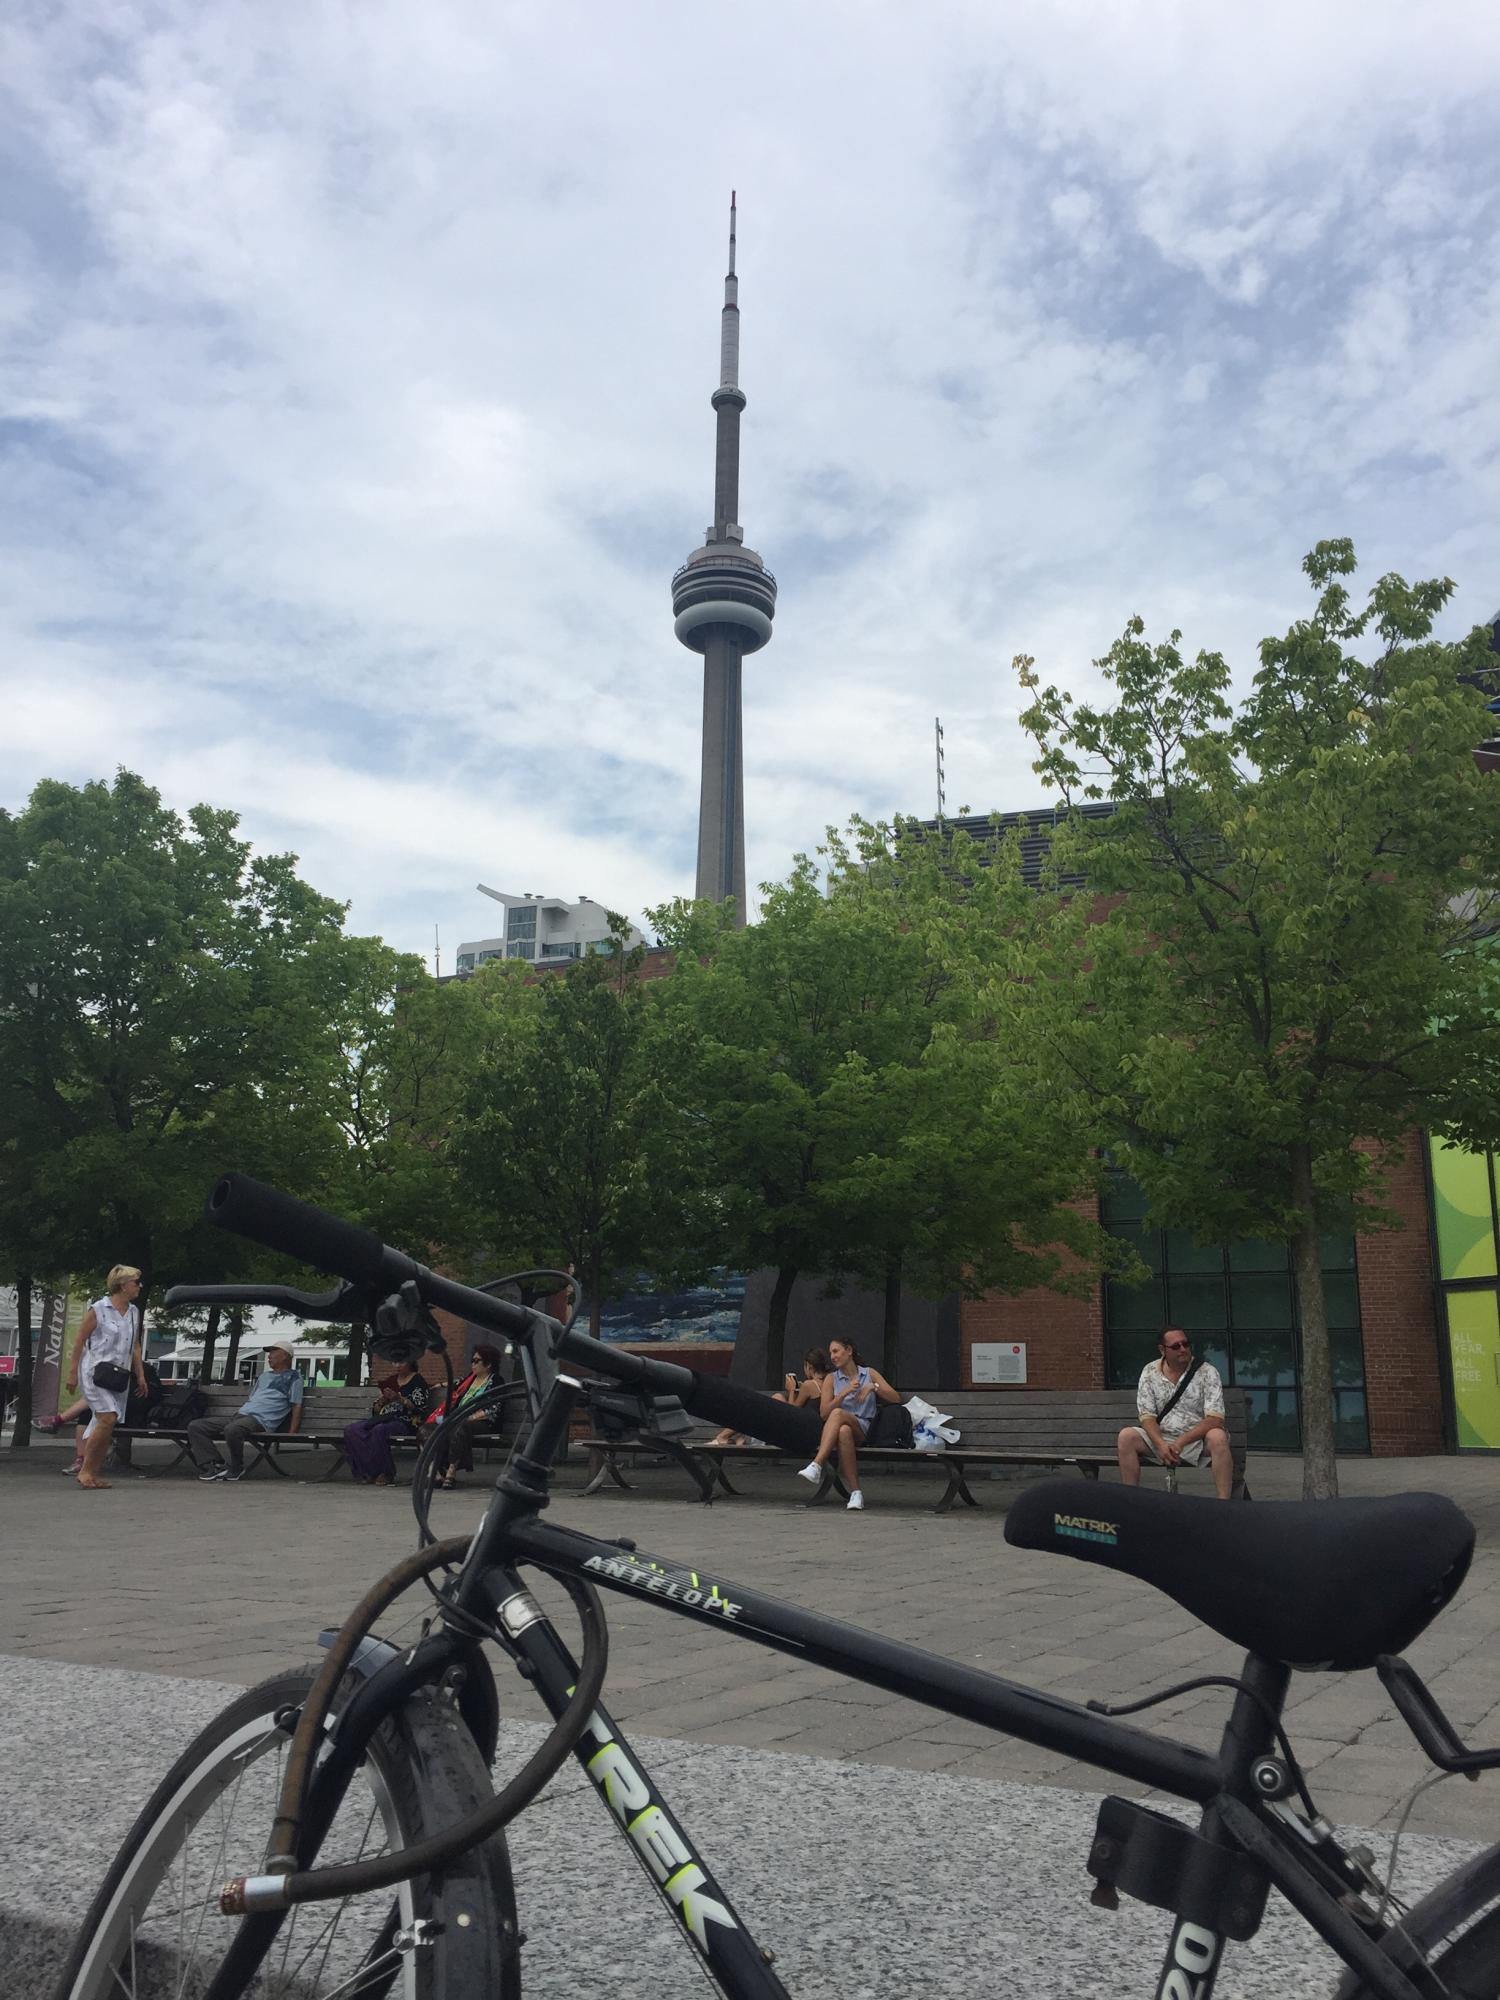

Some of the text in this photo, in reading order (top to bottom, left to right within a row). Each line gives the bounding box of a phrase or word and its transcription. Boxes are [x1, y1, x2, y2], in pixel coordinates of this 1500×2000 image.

[1455, 1358, 1475, 1369] ALL
[1456, 1370, 1482, 1382] FREE
[1054, 1512, 1120, 1535] MATRIX
[582, 1555, 743, 1619] ANTELOPE
